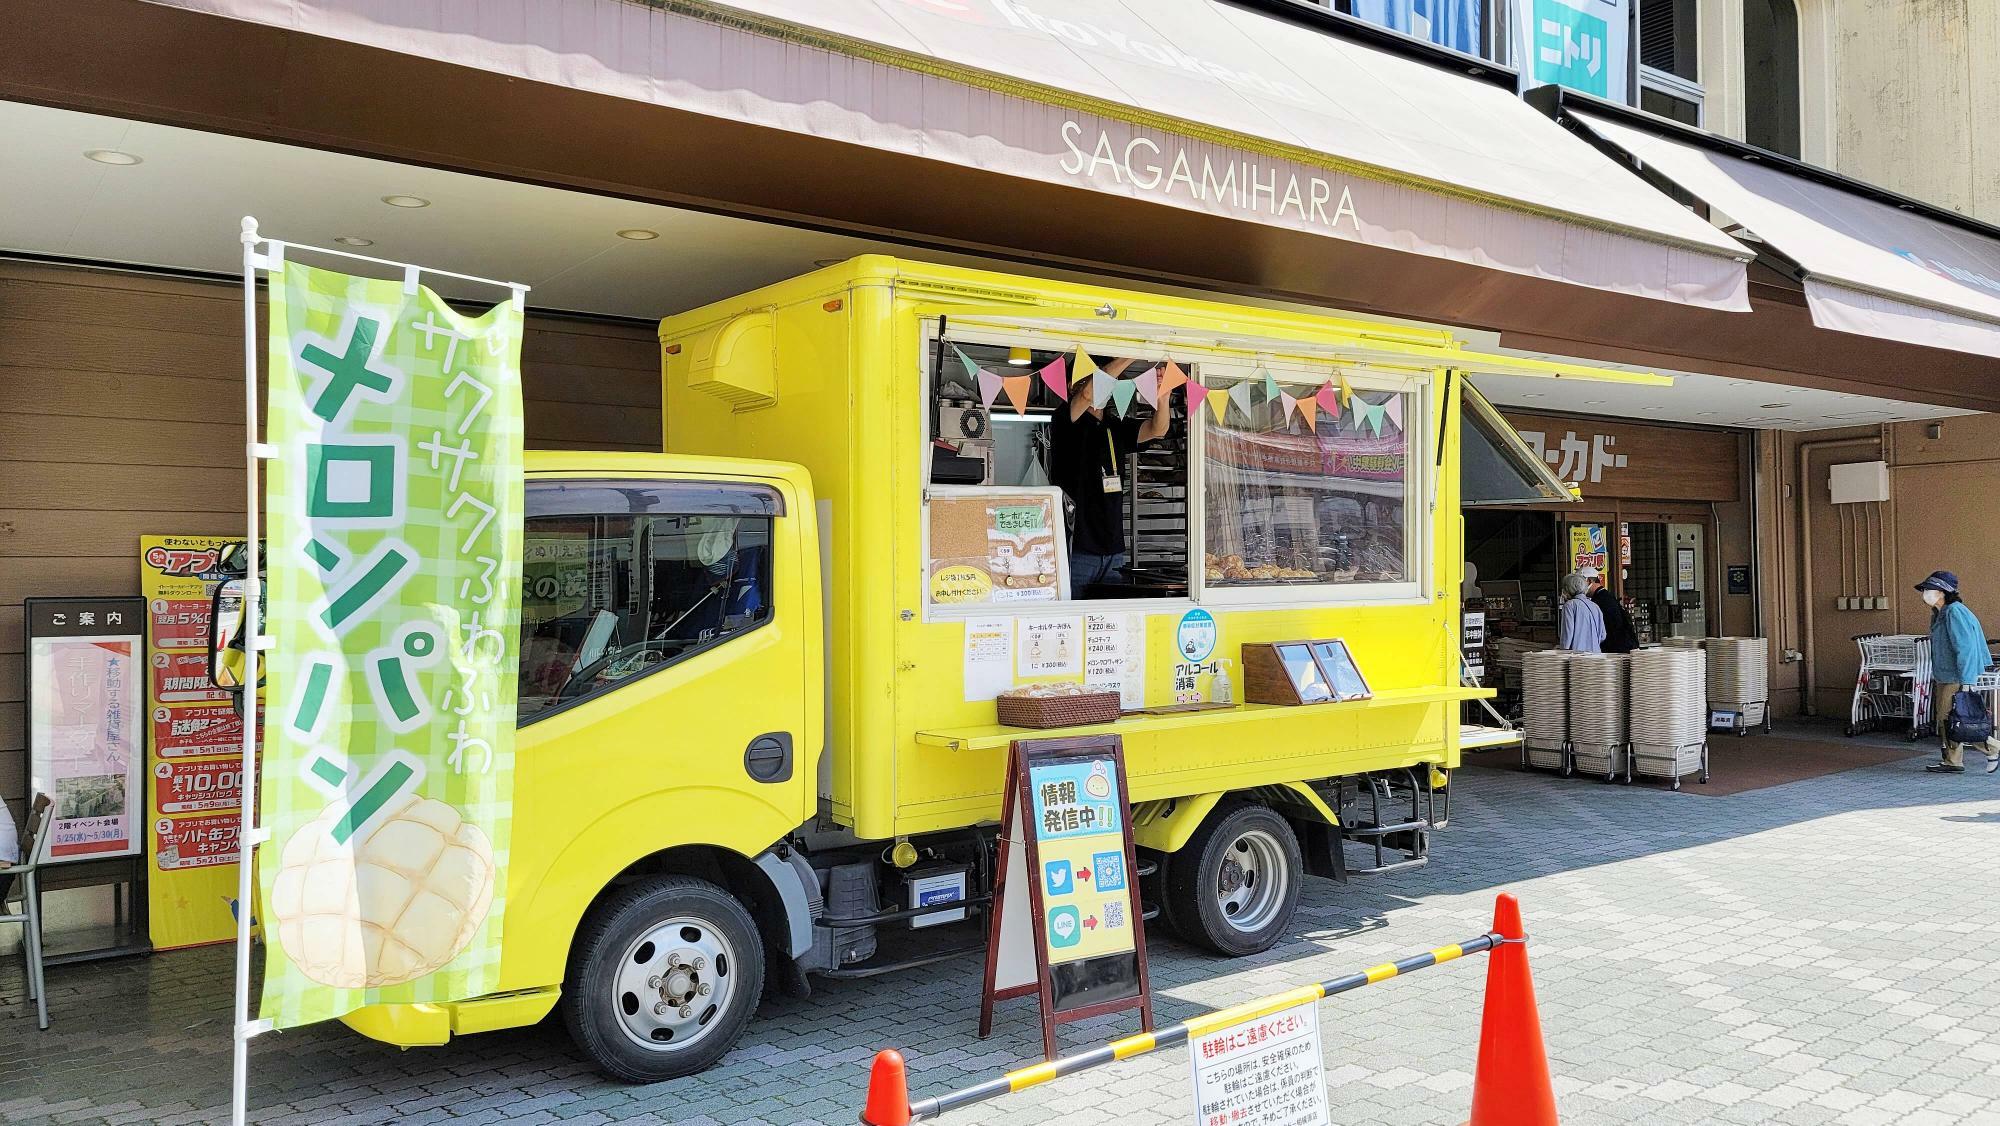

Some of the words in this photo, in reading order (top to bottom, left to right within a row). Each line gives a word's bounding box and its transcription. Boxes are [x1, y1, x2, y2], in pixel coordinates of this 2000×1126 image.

[1541, 18, 1601, 78] ニトリ
[1060, 121, 1361, 230] SAGAMIHARA
[999, 511, 1037, 520] キーホルダー
[412, 311, 507, 774] サクサクふわふわ
[167, 551, 220, 574] アプ
[294, 317, 434, 846] メロンパン
[155, 601, 163, 611] 1
[52, 612, 122, 626] ご案内
[156, 655, 165, 665] 2
[1176, 662, 1219, 676] アルコール
[1175, 676, 1195, 691] 消毒
[206, 691, 233, 699] 配信
[106, 667, 121, 762] 移動する雑貨屋さん
[157, 710, 166, 720] 3
[159, 765, 168, 775] 4
[177, 762, 243, 772] アプリでお買い物して
[1041, 781, 1077, 807] 情報
[58, 818, 119, 830] 2階イベント会場
[159, 821, 168, 831] 5
[182, 827, 241, 844] ハト缶プ
[1057, 919, 1073, 930] LINE
[1202, 1015, 1308, 1060] 駐輪はご遠慮ください。
[1206, 1041, 1312, 1085] こちらの場所は、安全確保のため
[1224, 1061, 1299, 1094] 駐輪はご遠慮ください。
[1238, 1096, 1323, 1126] ので、予めご了承ください。
